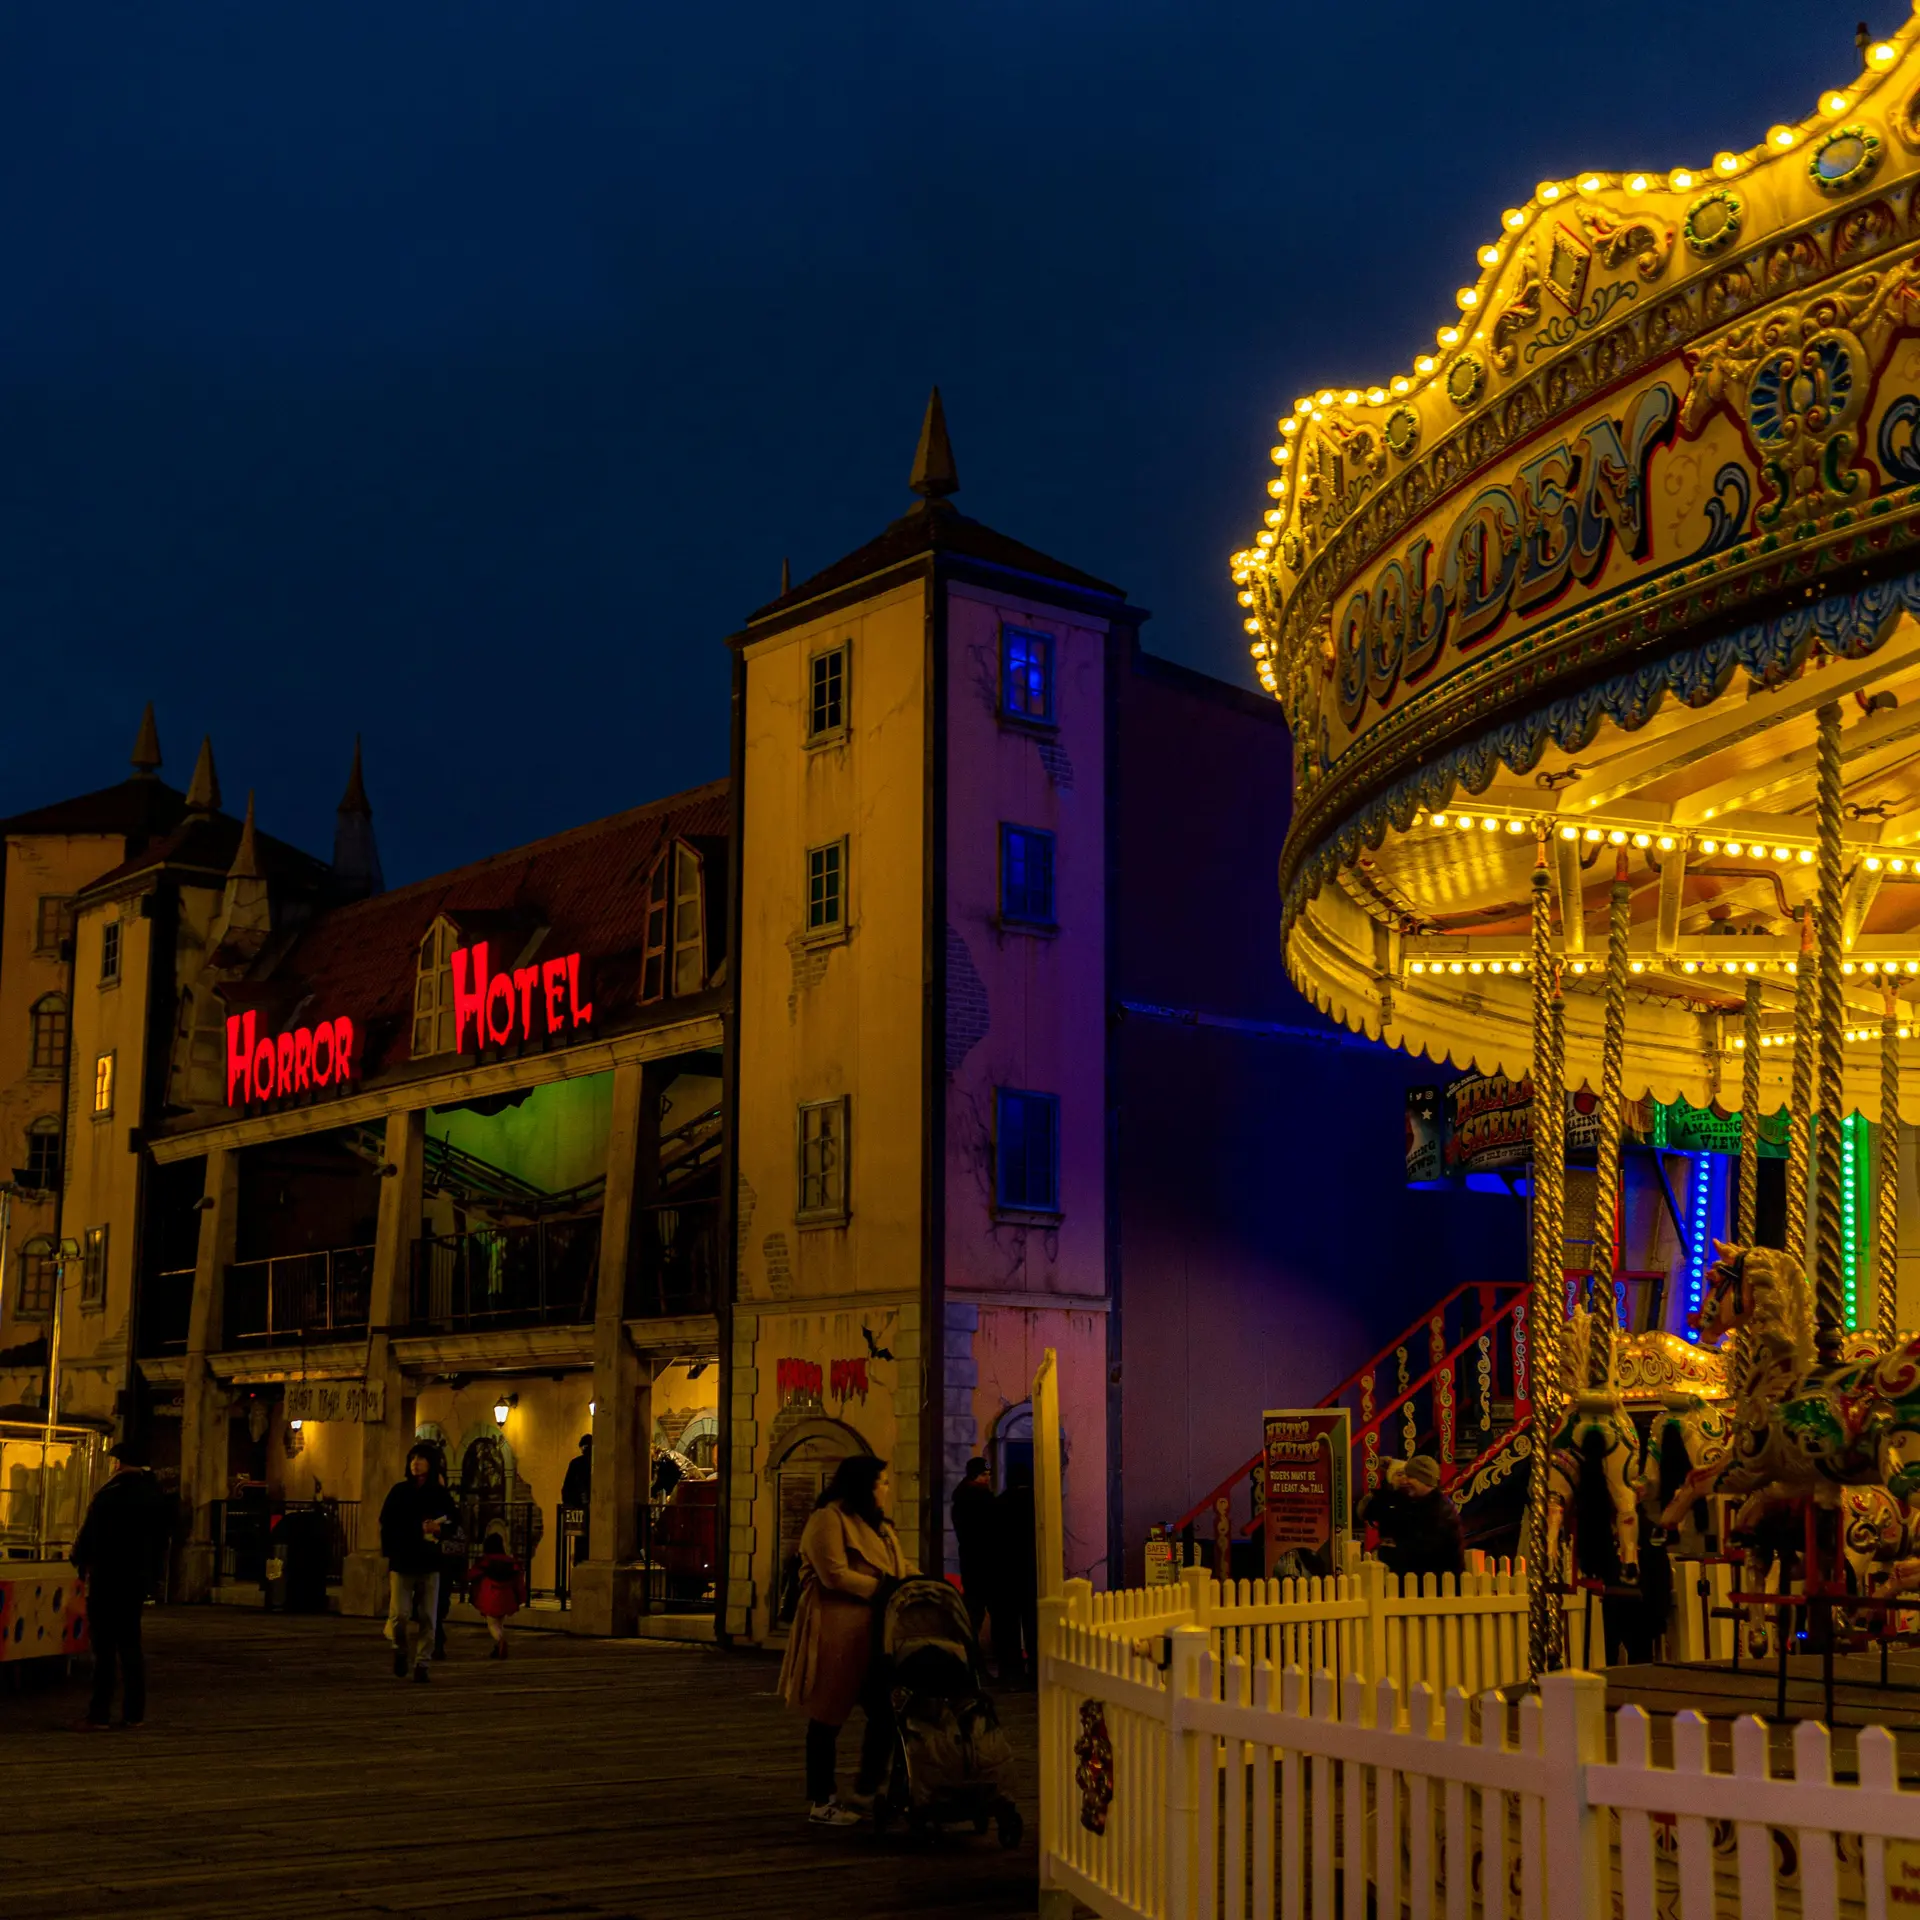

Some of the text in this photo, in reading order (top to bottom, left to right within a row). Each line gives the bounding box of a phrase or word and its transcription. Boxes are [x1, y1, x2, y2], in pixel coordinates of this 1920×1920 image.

[1337, 381, 1684, 726] GOLDEN
[226, 940, 593, 1108] HORROR HOTEL
[1681, 1120, 1742, 1136] AMAZING
[1265, 1421, 1310, 1448] HELTER
[1269, 1441, 1320, 1467] SKELTER
[1269, 1471, 1316, 1481] RIDERS MUST BE
[1273, 1483, 1280, 1493] AT
[1281, 1483, 1299, 1493] LEAST
[1310, 1483, 1325, 1494] TALL
[565, 1509, 584, 1523] EXIT
